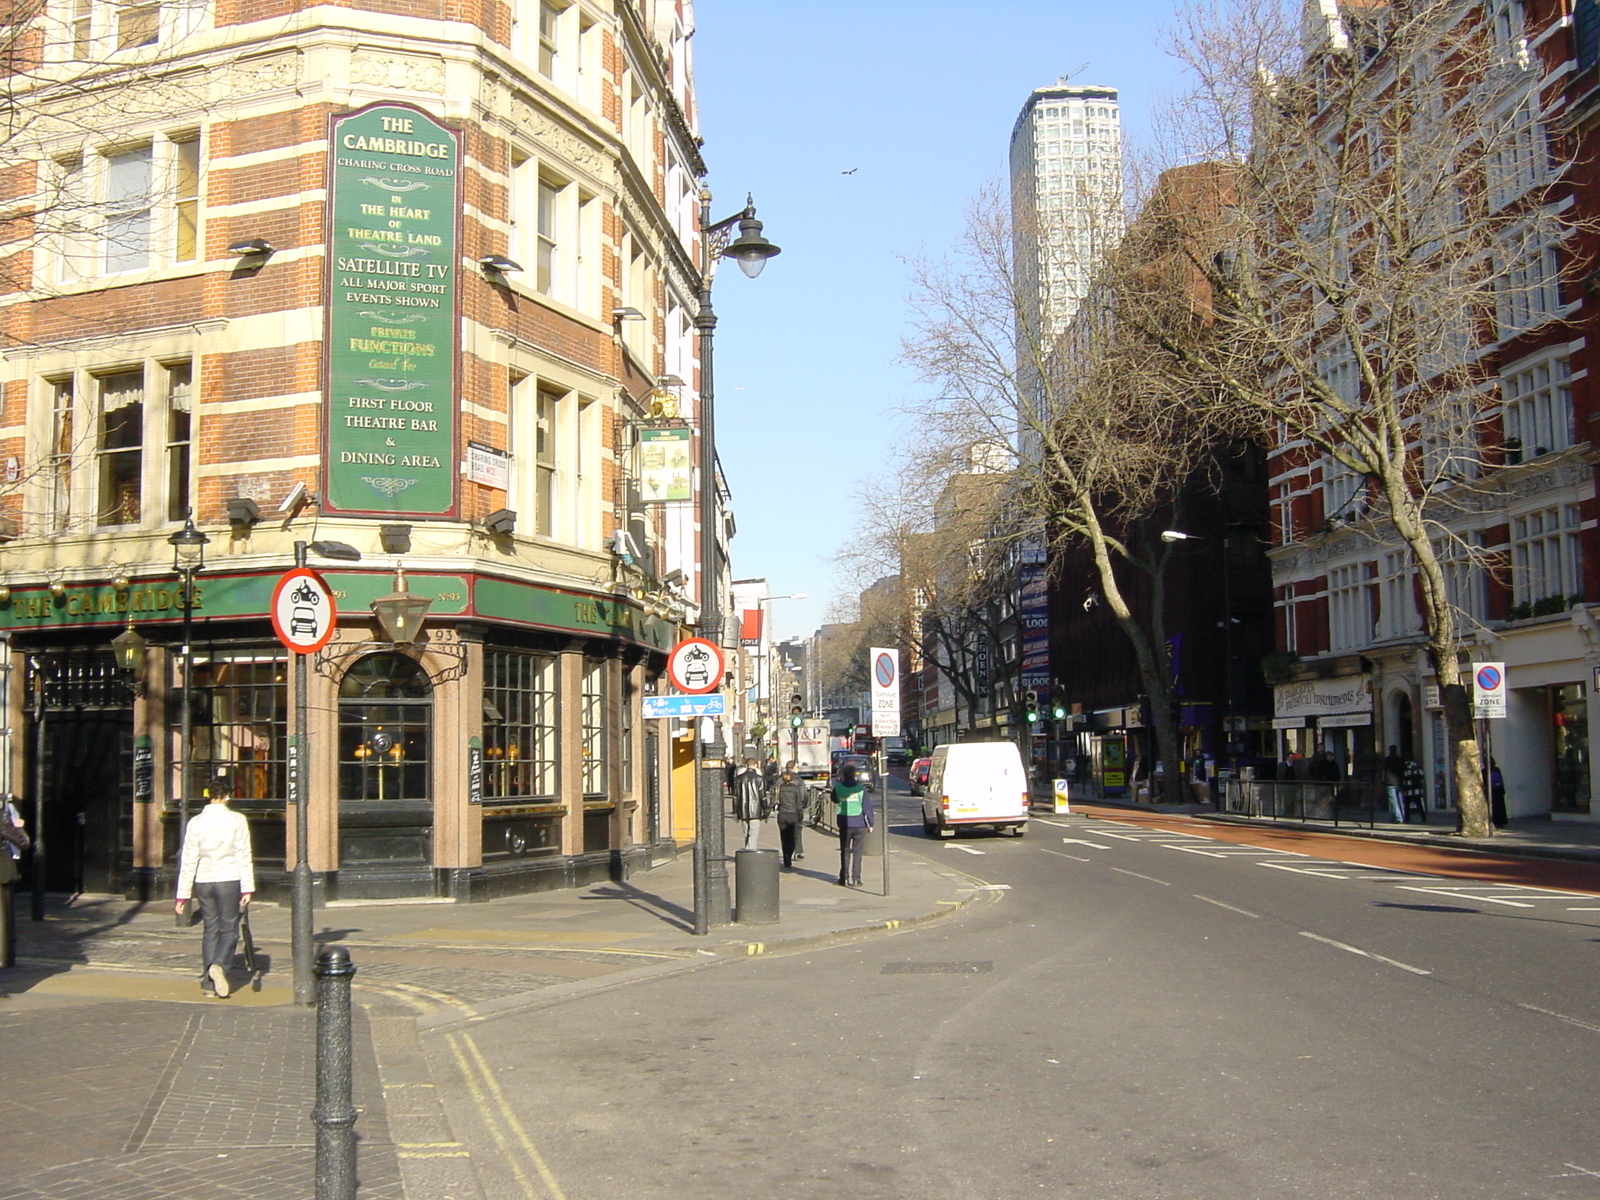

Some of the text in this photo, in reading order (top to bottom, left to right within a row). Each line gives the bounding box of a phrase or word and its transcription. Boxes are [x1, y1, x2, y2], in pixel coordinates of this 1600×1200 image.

[381, 116, 414, 134] THE
[343, 134, 449, 159] CAMBRIDGE
[337, 157, 454, 177] CHARING CROSS ROAD
[391, 195, 402, 203] IN
[360, 203, 431, 220] THE HEART
[388, 220, 402, 229] OF
[347, 227, 442, 246] THEATRE LAND
[338, 256, 449, 279] SATELLITE TV
[340, 277, 447, 296] ALL MAJOR SPORT
[346, 292, 440, 309] EVENTS SHOWN
[370, 326, 416, 339] PRIVATE
[349, 337, 436, 357] FUNCTIONS
[349, 397, 434, 413] FIRST FLOOR
[344, 415, 438, 432] THEATRE BAR
[385, 436, 397, 447] &
[341, 451, 442, 468] DINING AREA
[13, 588, 203, 619] THE CAMBRIDGE
[574, 602, 598, 625] THE
[435, 630, 453, 641] 93
[878, 700, 894, 708] ZONE
[1479, 698, 1501, 706] ZONE
